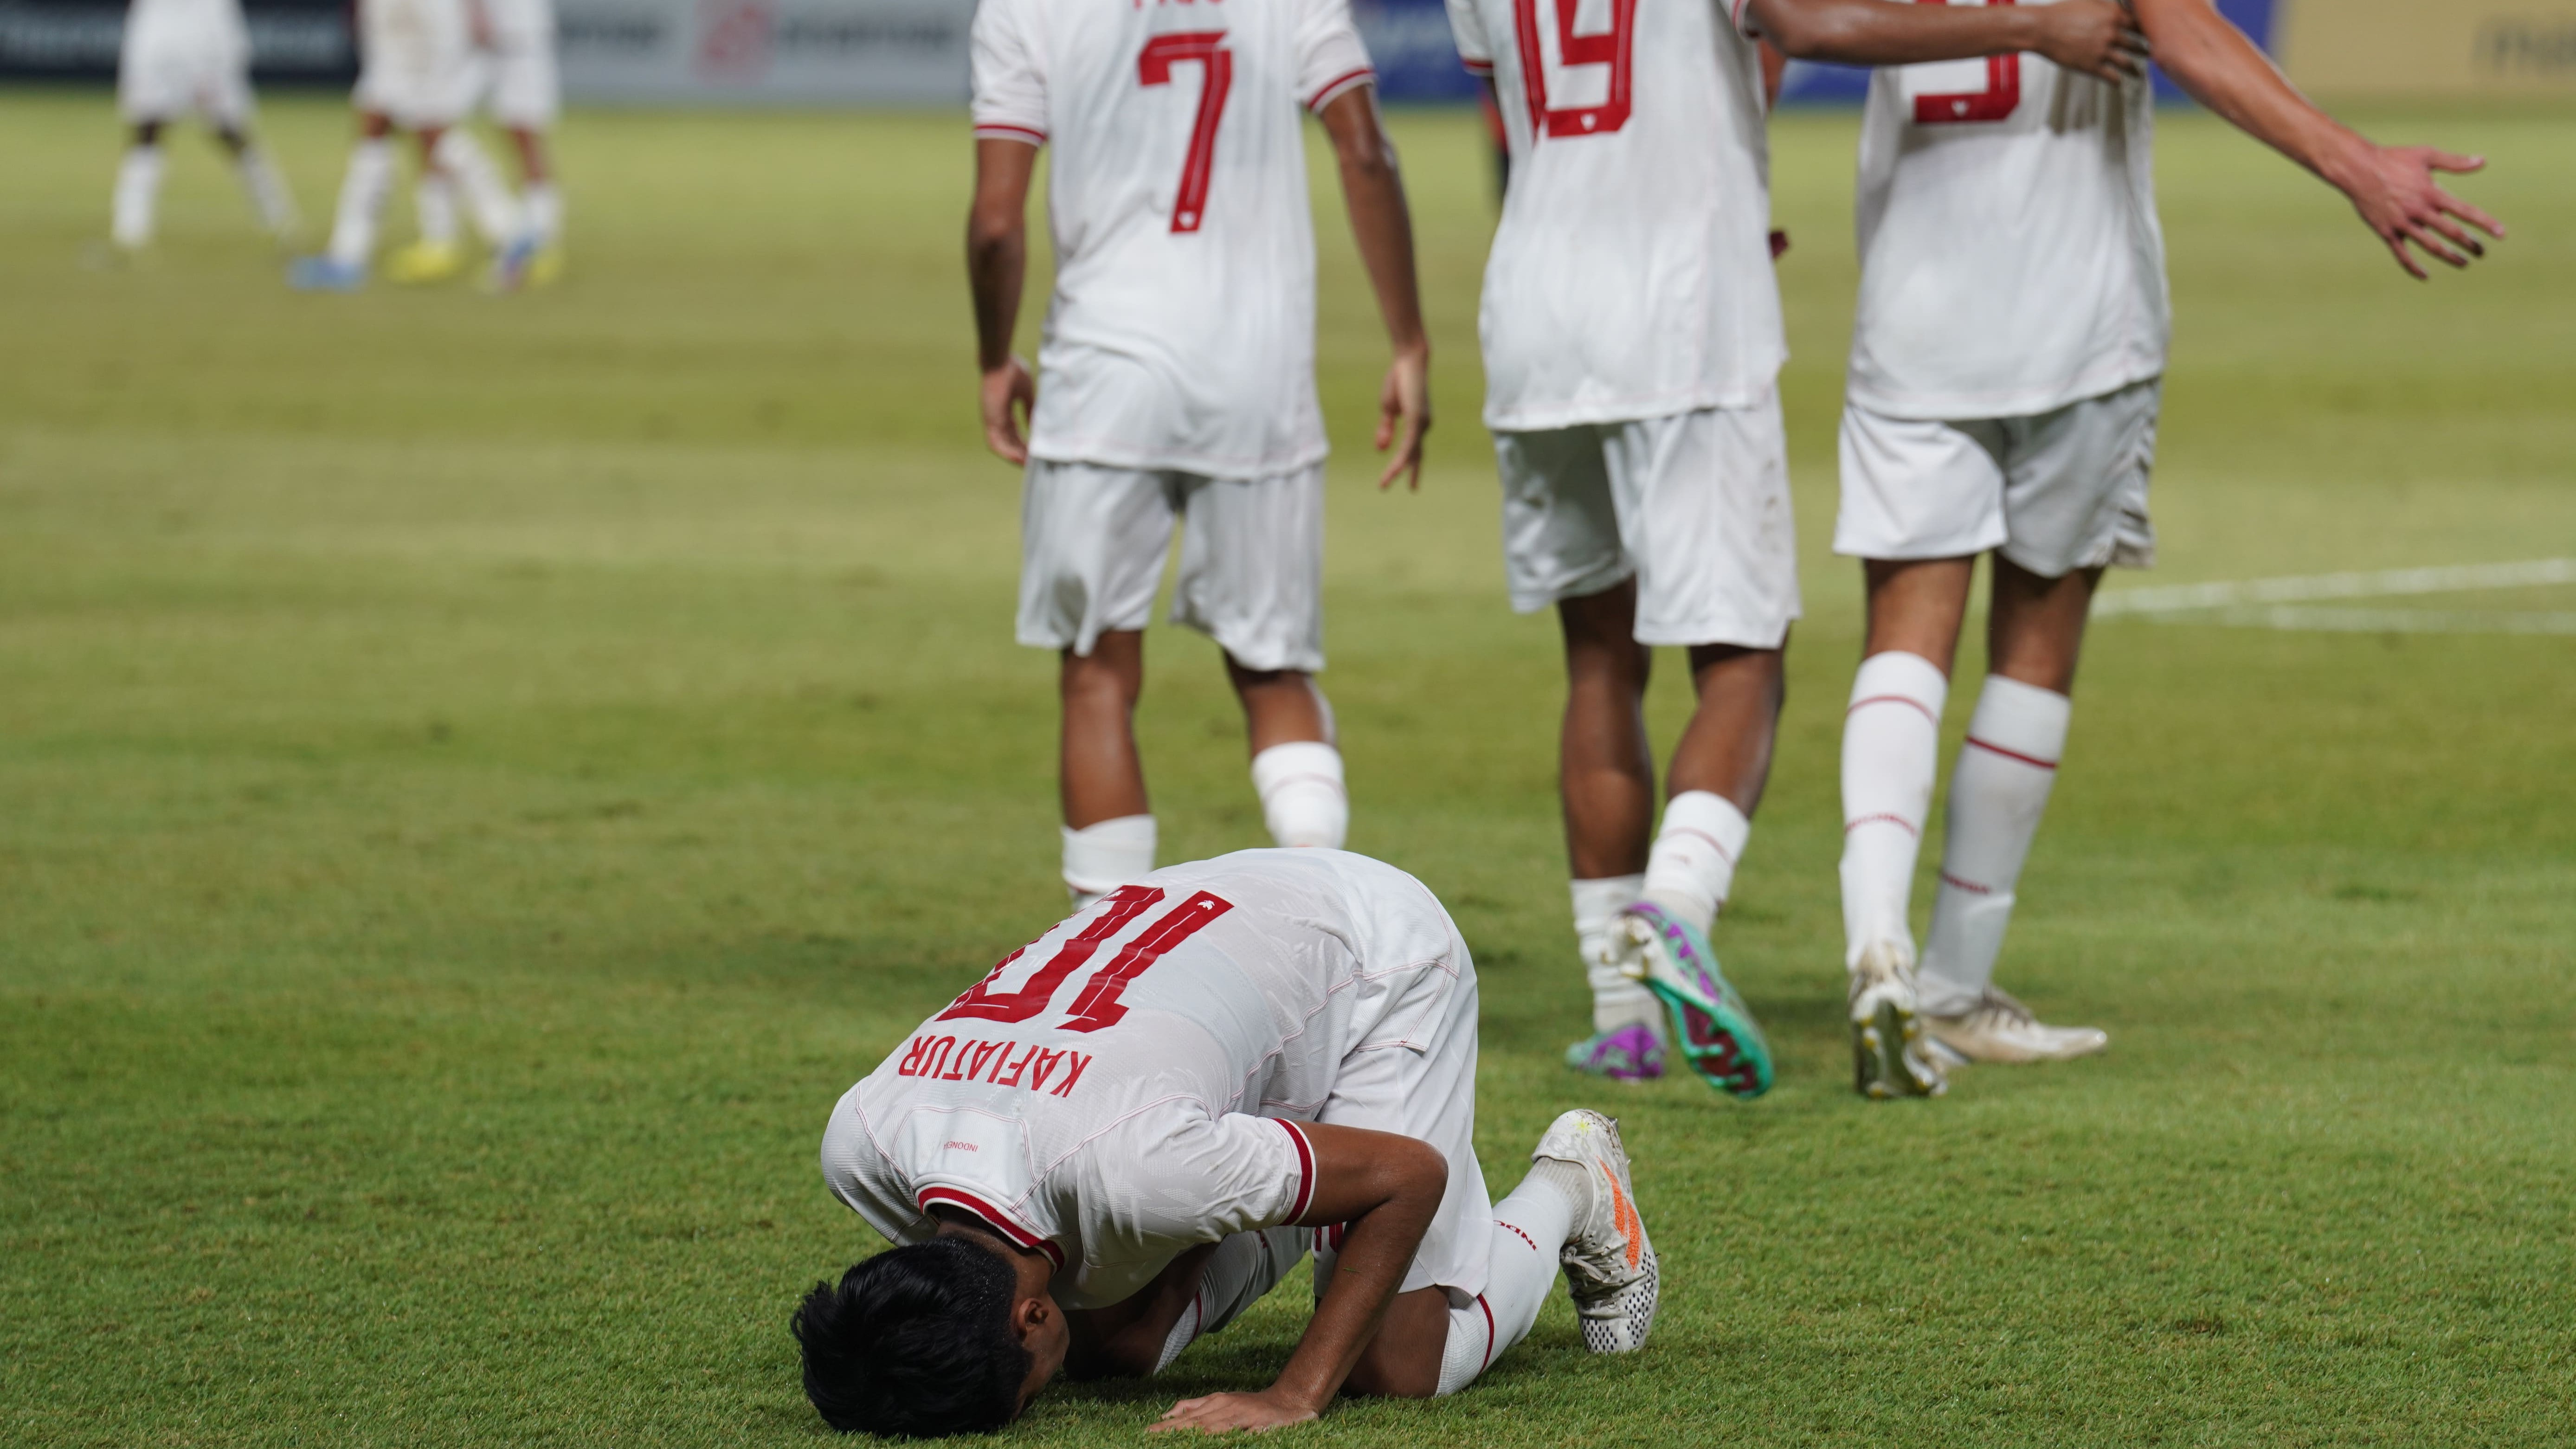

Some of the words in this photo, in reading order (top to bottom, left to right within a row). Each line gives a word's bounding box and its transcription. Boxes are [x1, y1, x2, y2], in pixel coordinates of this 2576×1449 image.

[1138, 30, 1233, 233] 7
[1513, 0, 1636, 148] 19
[933, 885, 1235, 1033] 10
[898, 1035, 1093, 1098] KAFIATUR
